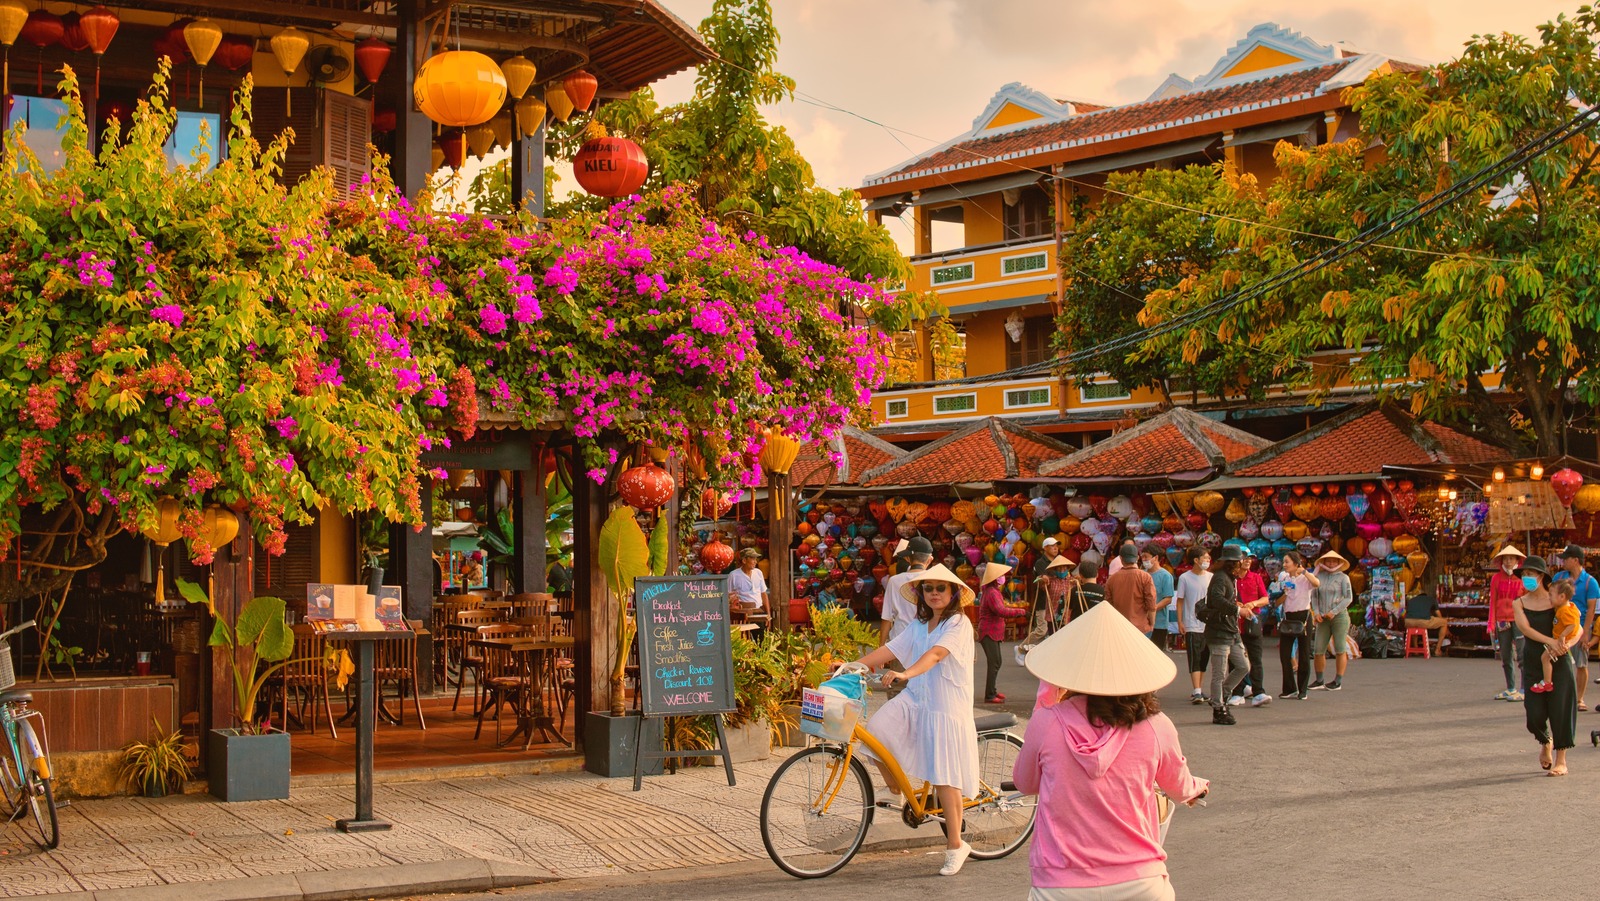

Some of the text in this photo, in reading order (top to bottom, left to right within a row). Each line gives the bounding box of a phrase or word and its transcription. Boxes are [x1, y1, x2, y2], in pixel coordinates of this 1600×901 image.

[584, 158, 617, 172] KIEU
[652, 599, 682, 612] Breakfast
[703, 611, 723, 620] Foods
[653, 626, 678, 641] Coffee
[655, 638, 695, 652] Fresh Juice
[654, 651, 692, 665] Smoothies
[689, 664, 712, 675] Review
[664, 677, 692, 688] Discount
[663, 691, 714, 706] WELCOME
